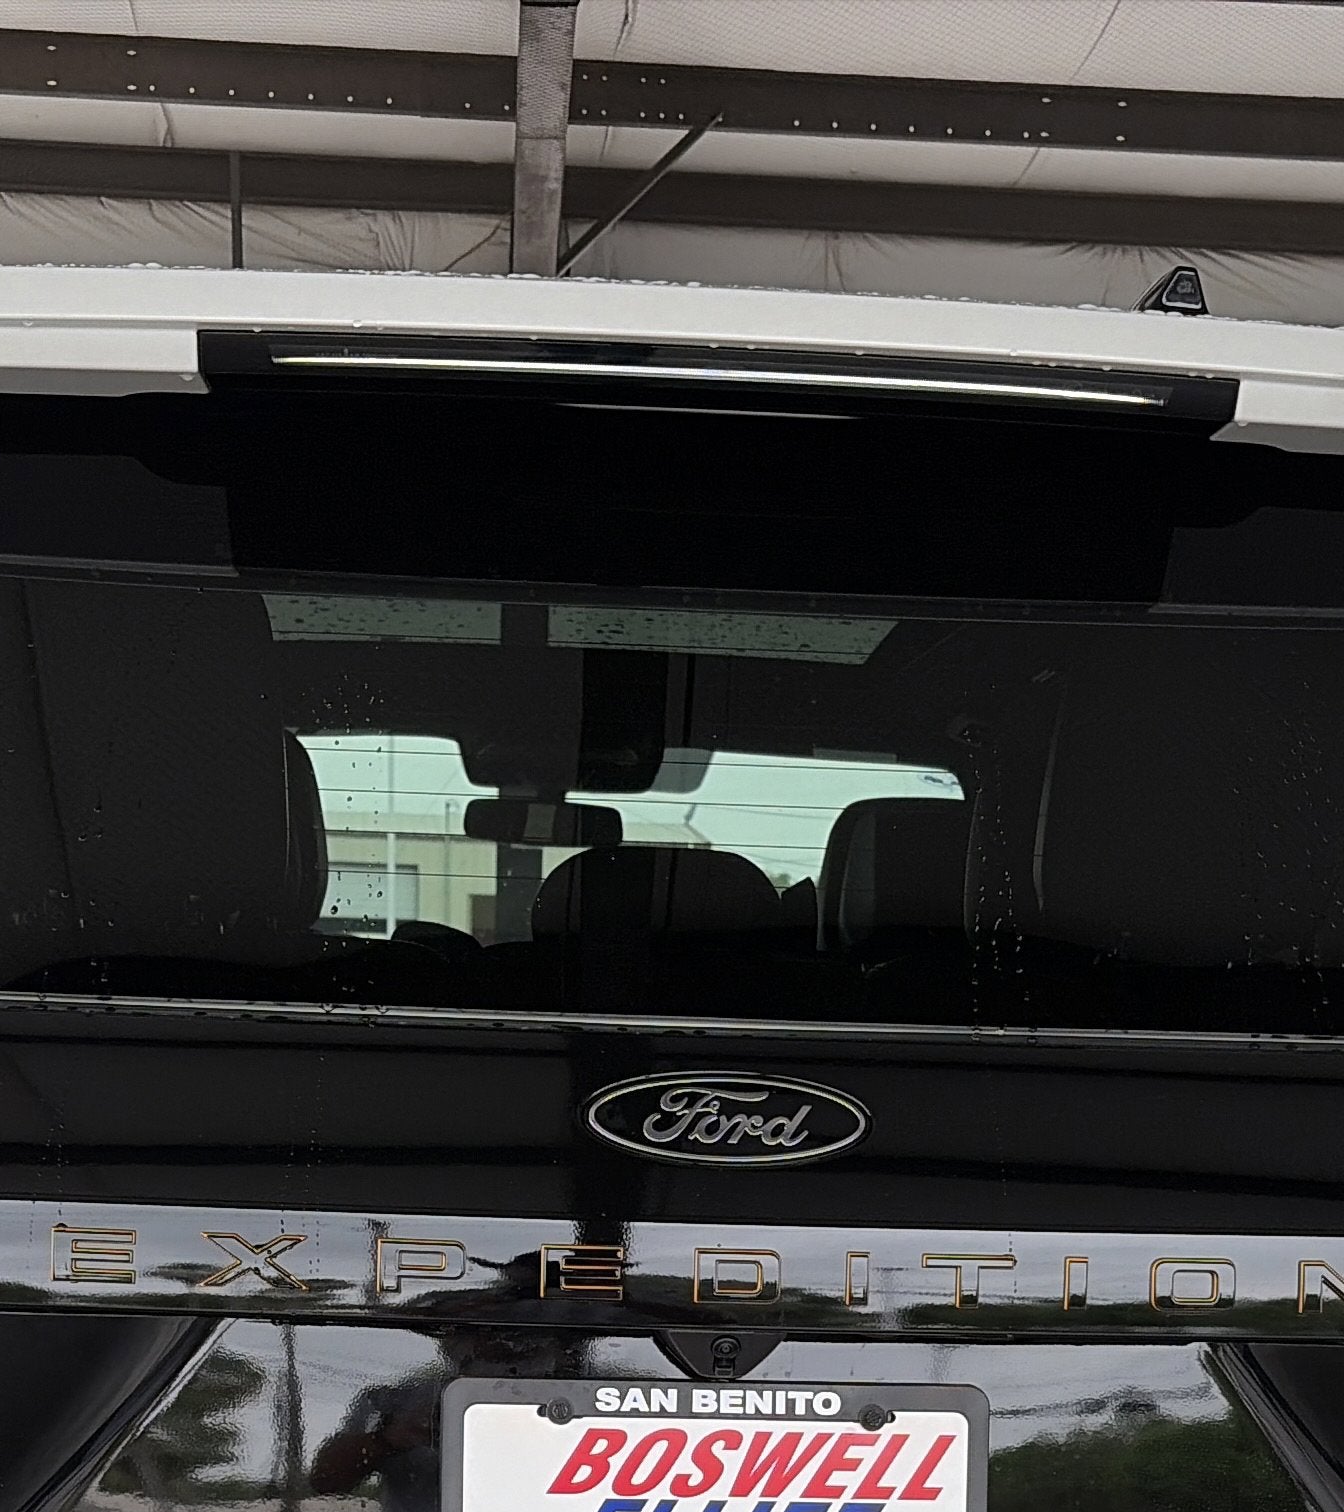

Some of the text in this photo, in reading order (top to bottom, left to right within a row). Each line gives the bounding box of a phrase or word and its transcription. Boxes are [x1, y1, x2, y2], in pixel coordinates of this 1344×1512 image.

[643, 1086, 812, 1147] Ford
[594, 1387, 842, 1416] SAN BENITO
[546, 1428, 957, 1500] BOSWELL
